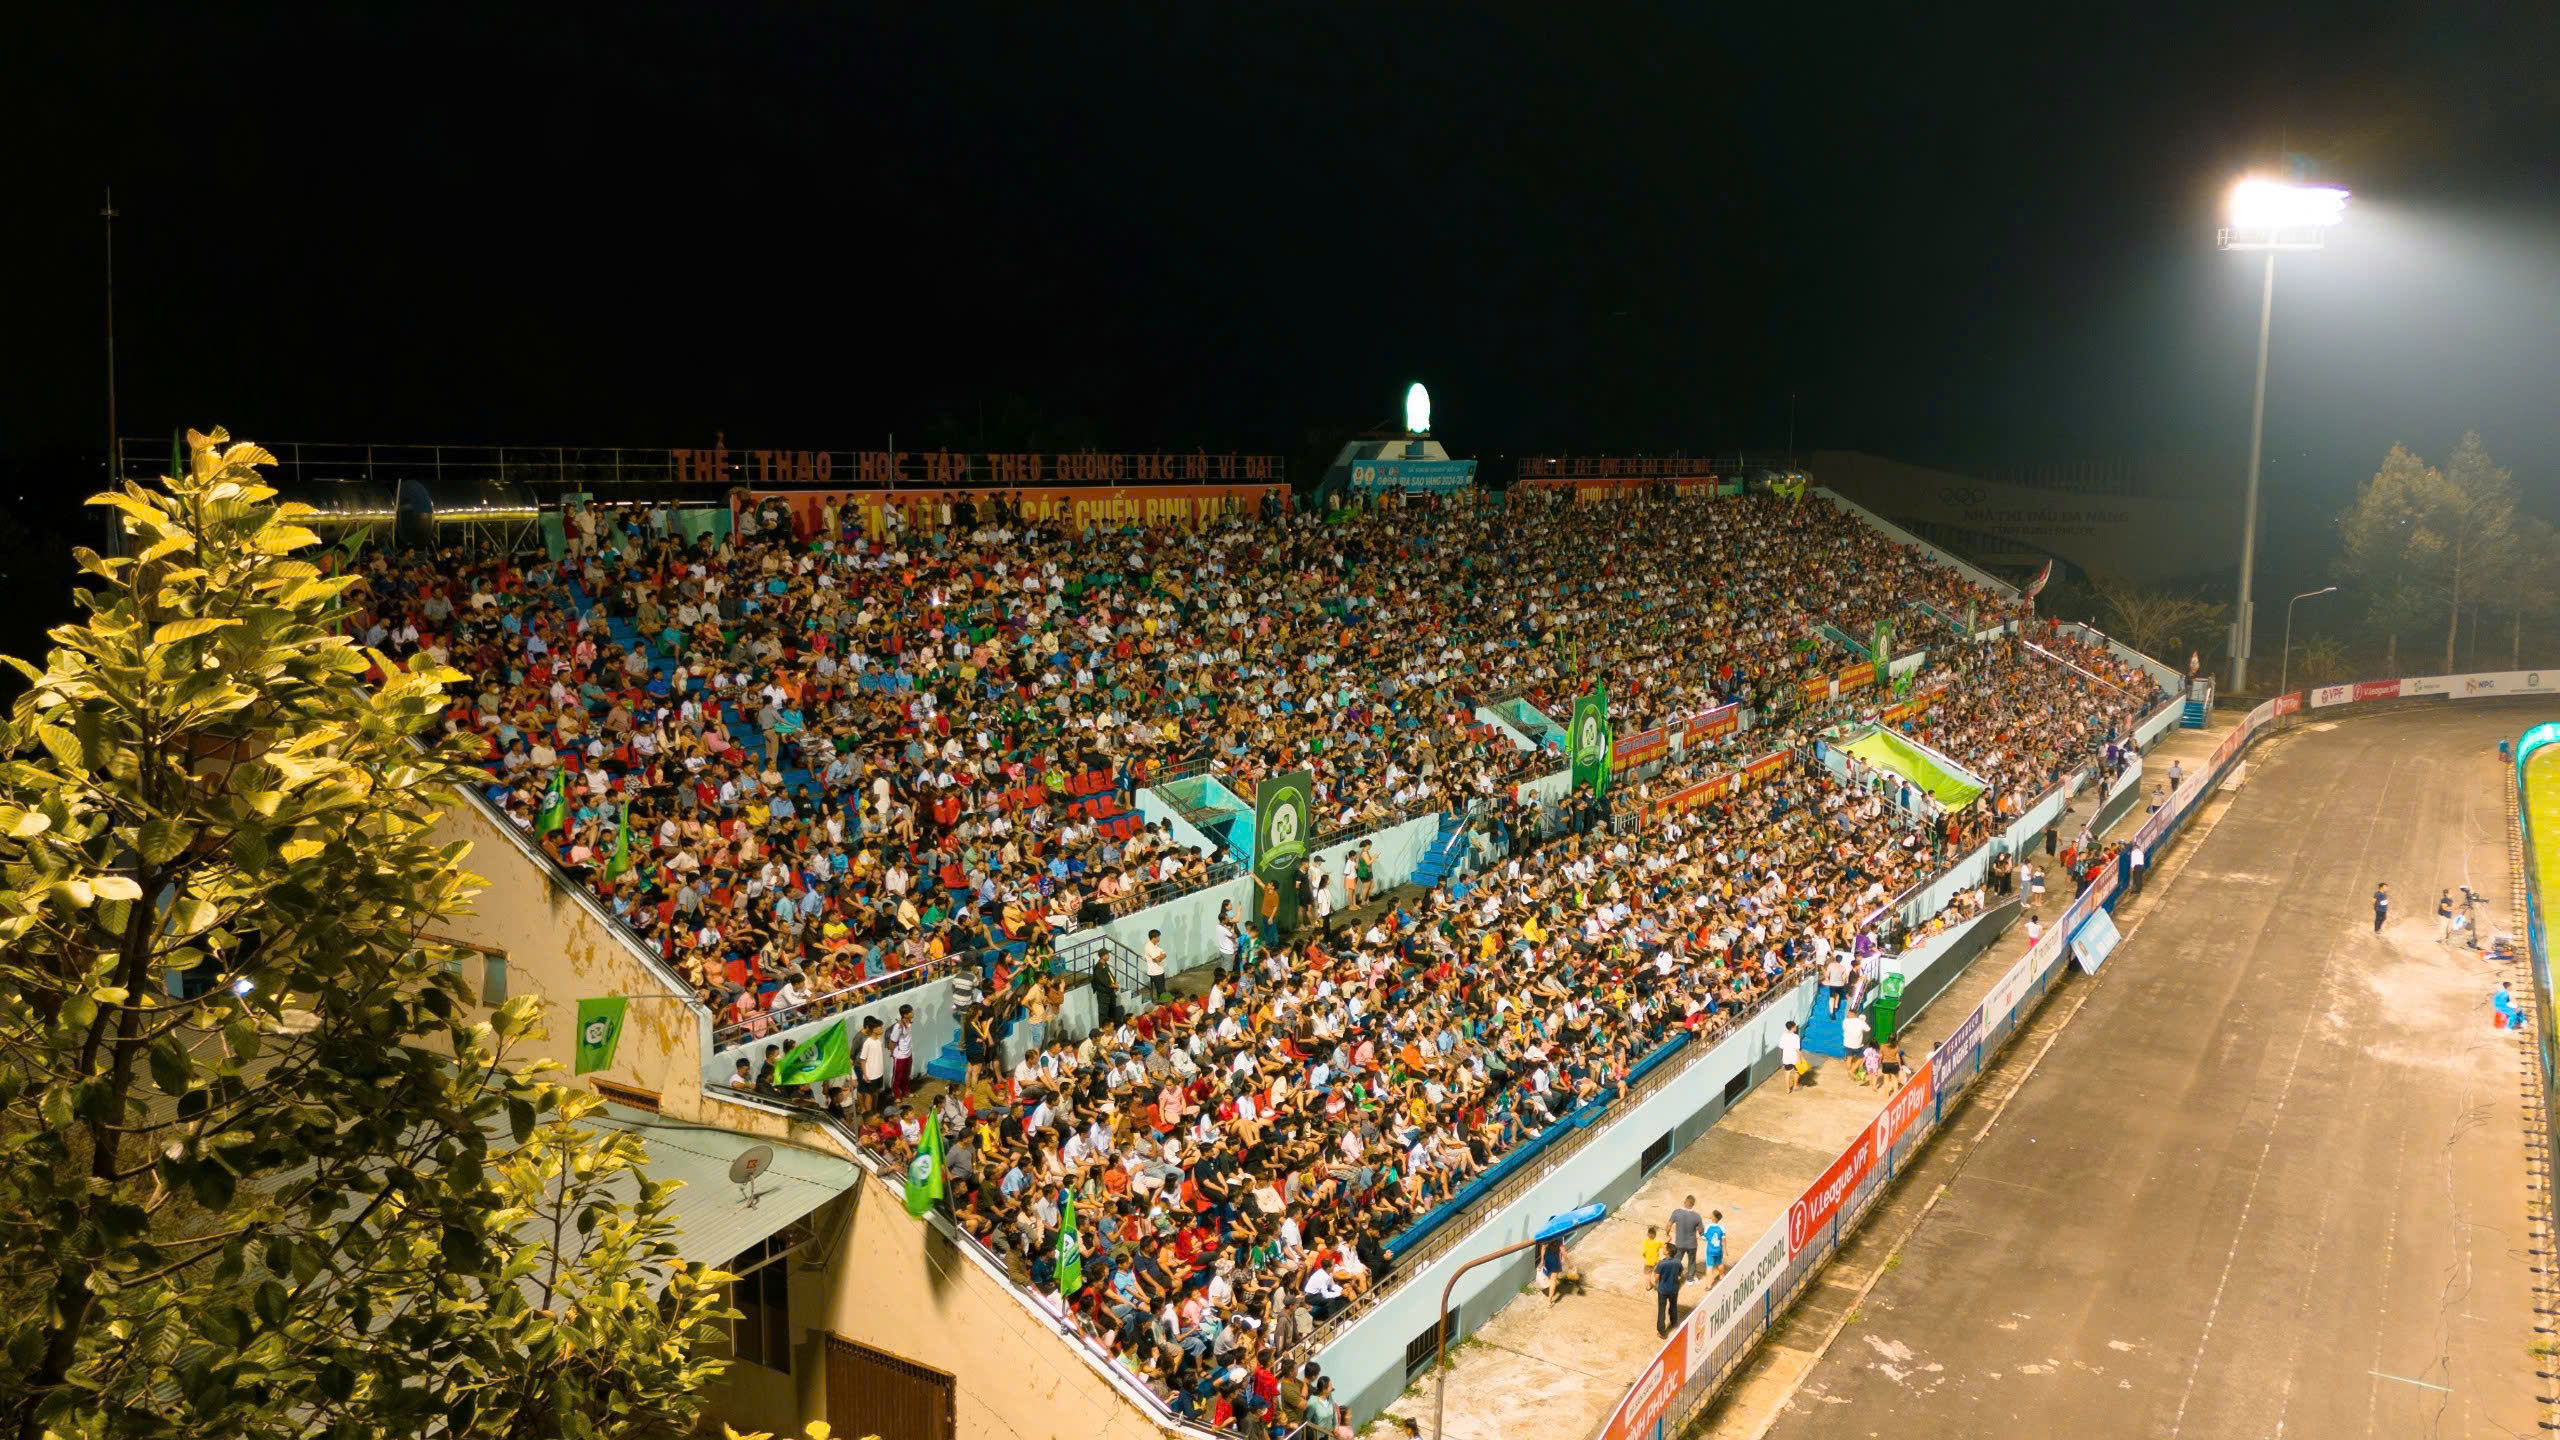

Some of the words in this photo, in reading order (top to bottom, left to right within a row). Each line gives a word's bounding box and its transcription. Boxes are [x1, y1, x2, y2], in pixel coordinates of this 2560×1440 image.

[754, 449, 832, 481] THAO
[1075, 489, 1139, 533] CHIẾN
[2329, 688, 2344, 700] VPF
[1889, 1097, 1908, 1138] FPT
[1907, 1084, 1927, 1111] Play
[1757, 1235, 1786, 1286] SCHOOL
